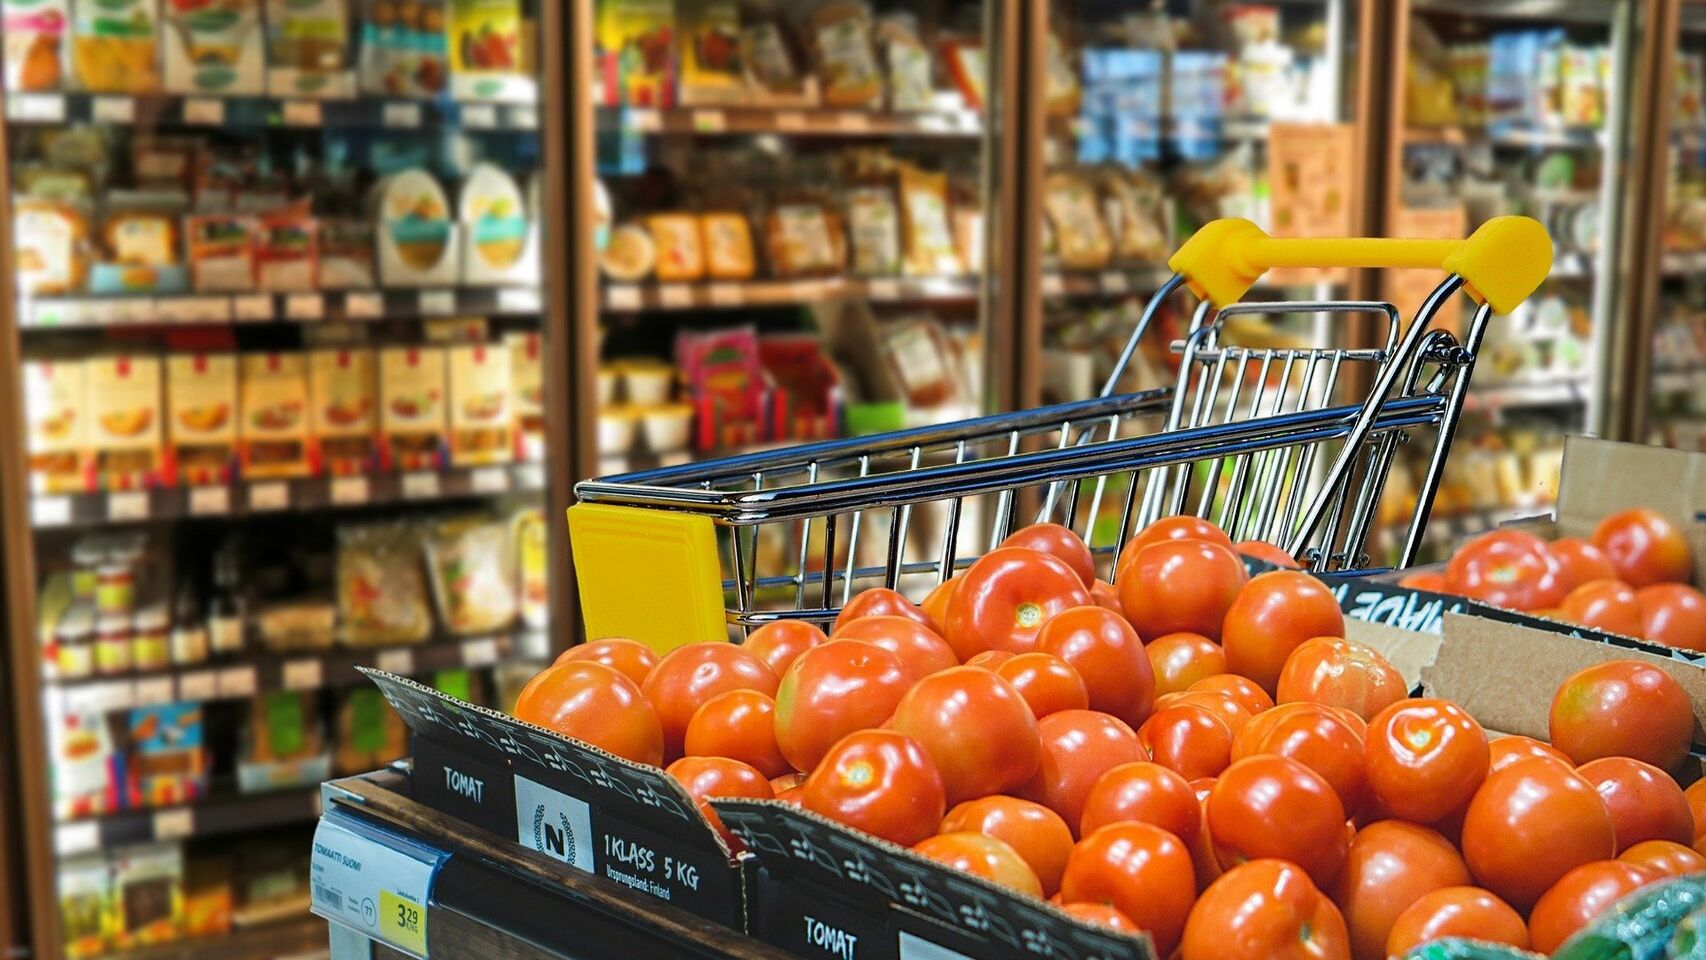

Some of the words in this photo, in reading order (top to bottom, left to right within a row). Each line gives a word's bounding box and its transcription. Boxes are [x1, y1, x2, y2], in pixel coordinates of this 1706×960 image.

[443, 766, 484, 803] TOMAT
[544, 823, 565, 856] N
[649, 881, 670, 900] Finland
[664, 856, 673, 880] 5
[677, 860, 700, 891] KG
[803, 915, 858, 960] TOMAT
